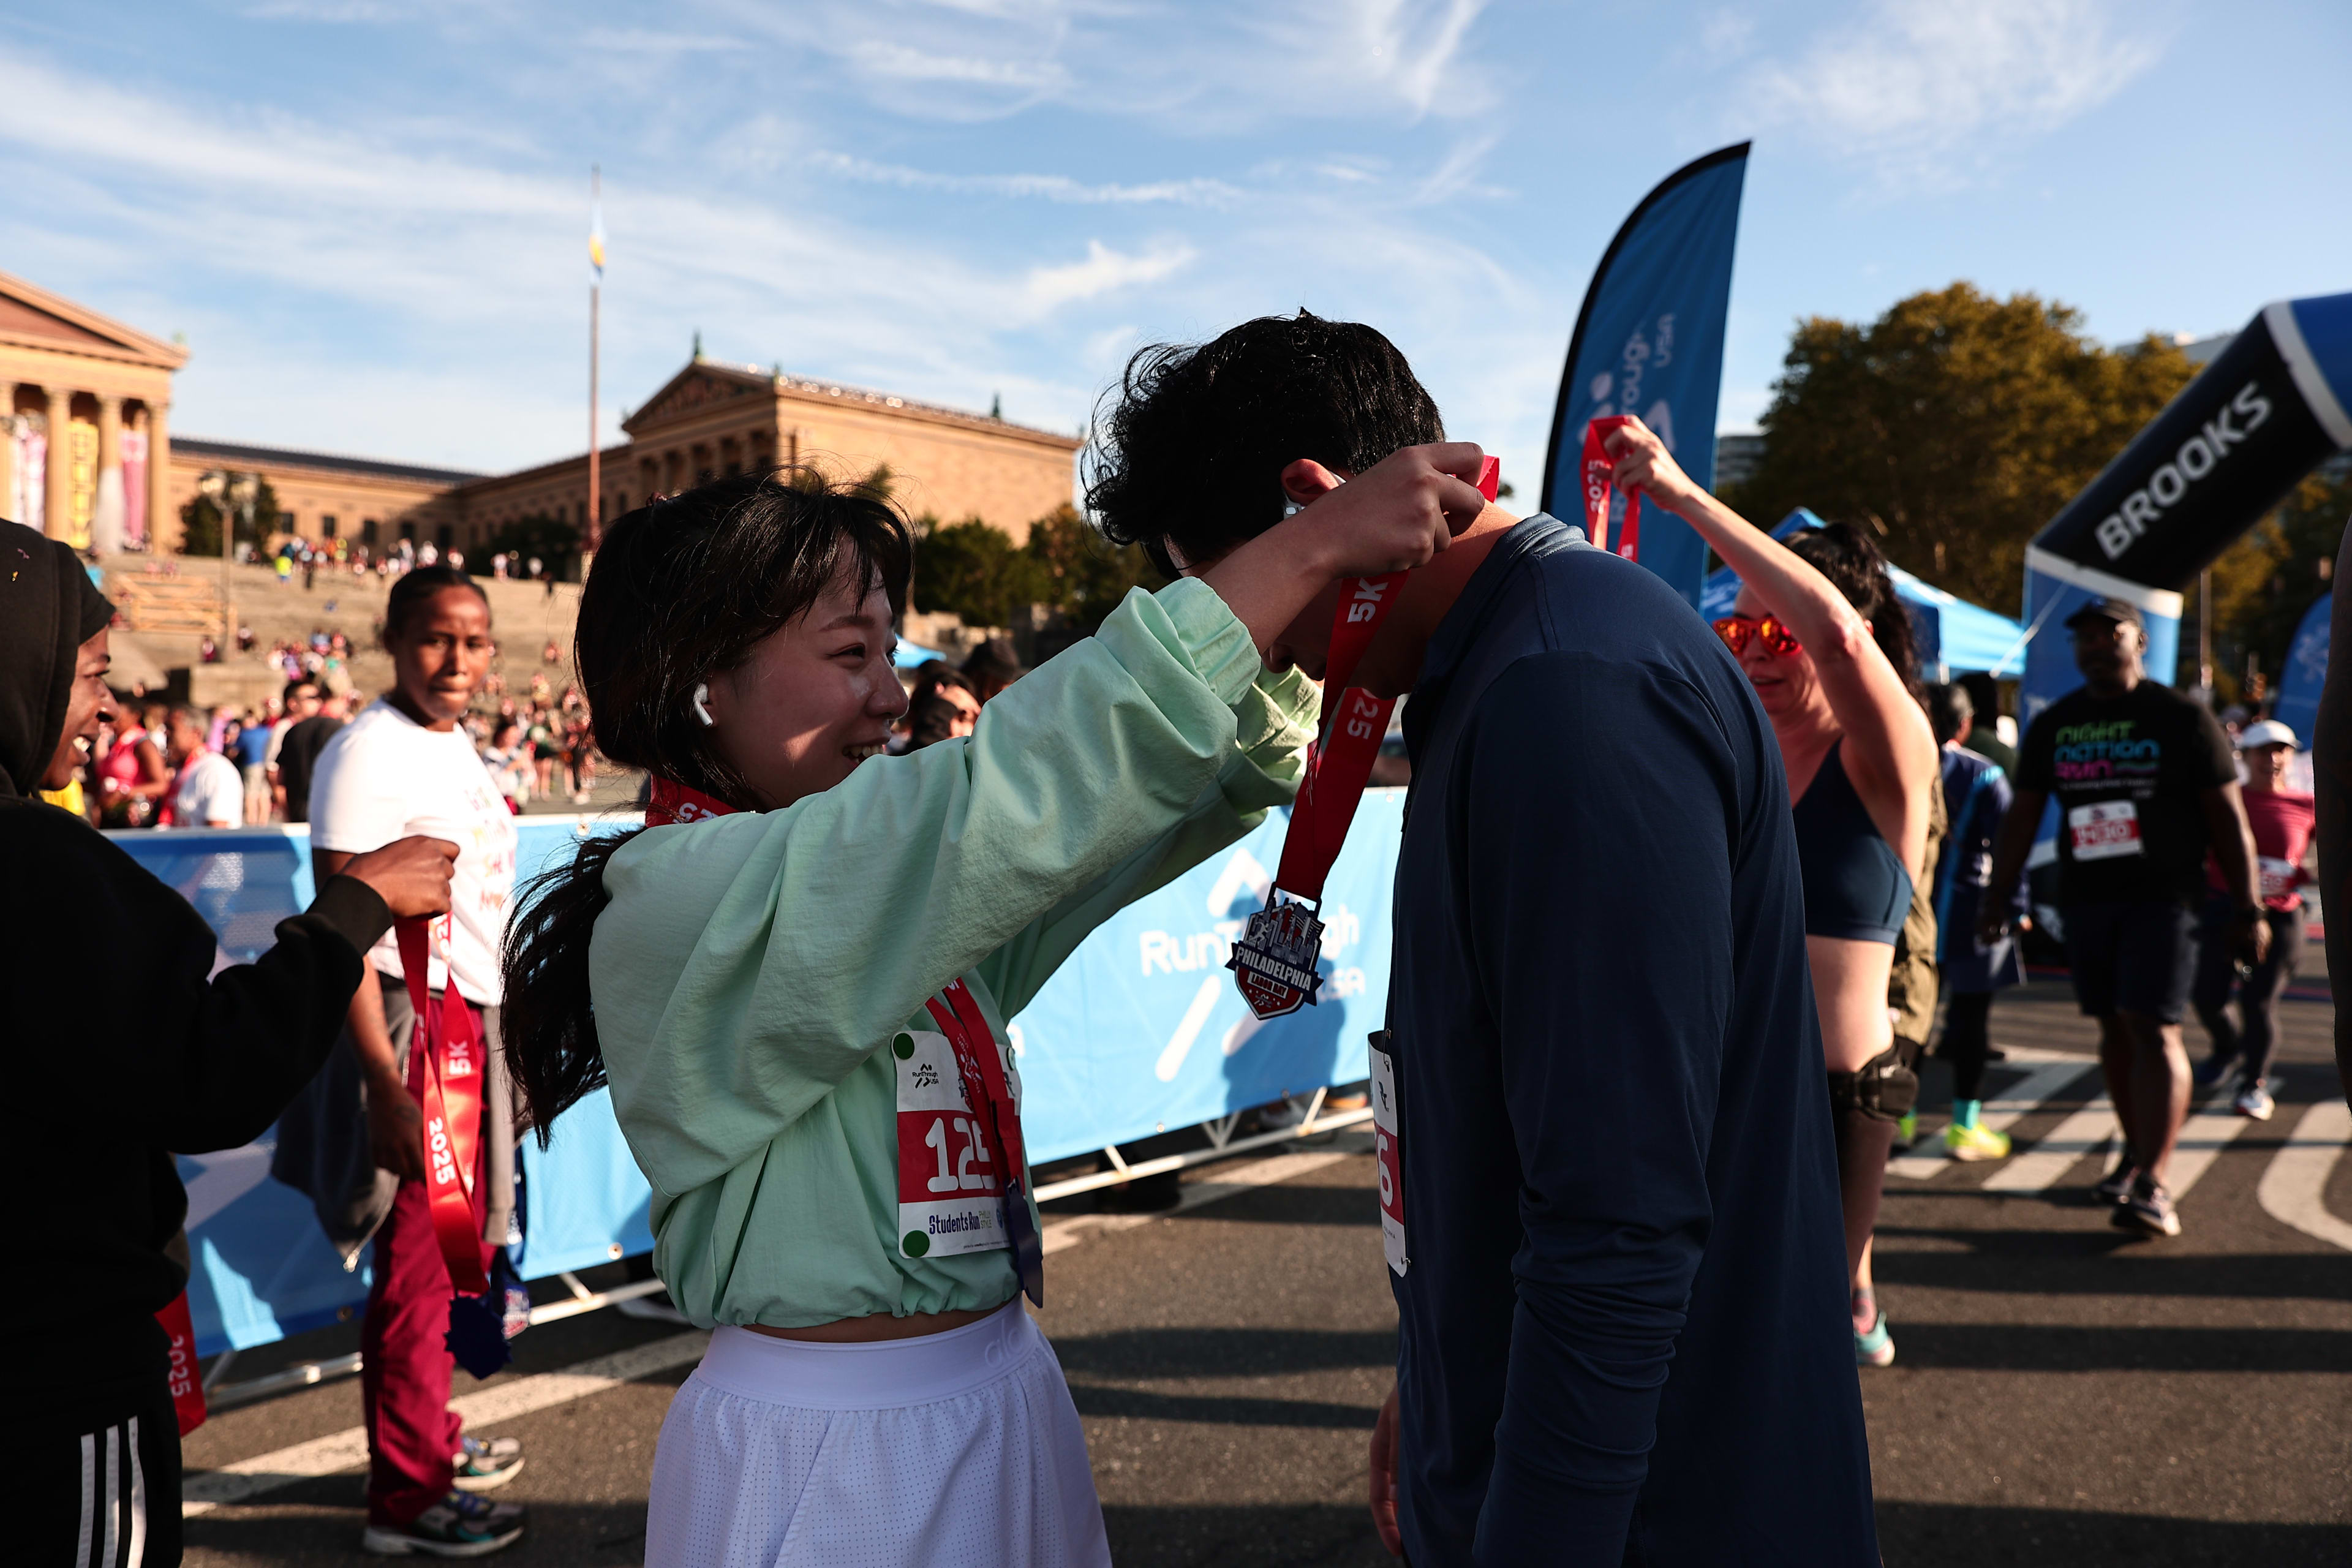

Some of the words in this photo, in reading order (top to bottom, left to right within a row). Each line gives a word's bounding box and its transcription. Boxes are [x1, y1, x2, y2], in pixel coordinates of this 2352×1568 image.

[1654, 312, 1677, 368] USA
[2094, 380, 2272, 561] BROOKS
[1347, 577, 1389, 623] 5K
[1347, 687, 1378, 740] 25
[1235, 945, 1312, 992] PHILADELPHIA
[448, 1041, 472, 1076] 5K
[428, 1116, 456, 1186] 2025
[980, 1219, 992, 1229] STYLE
[168, 1335, 192, 1397] 2025
